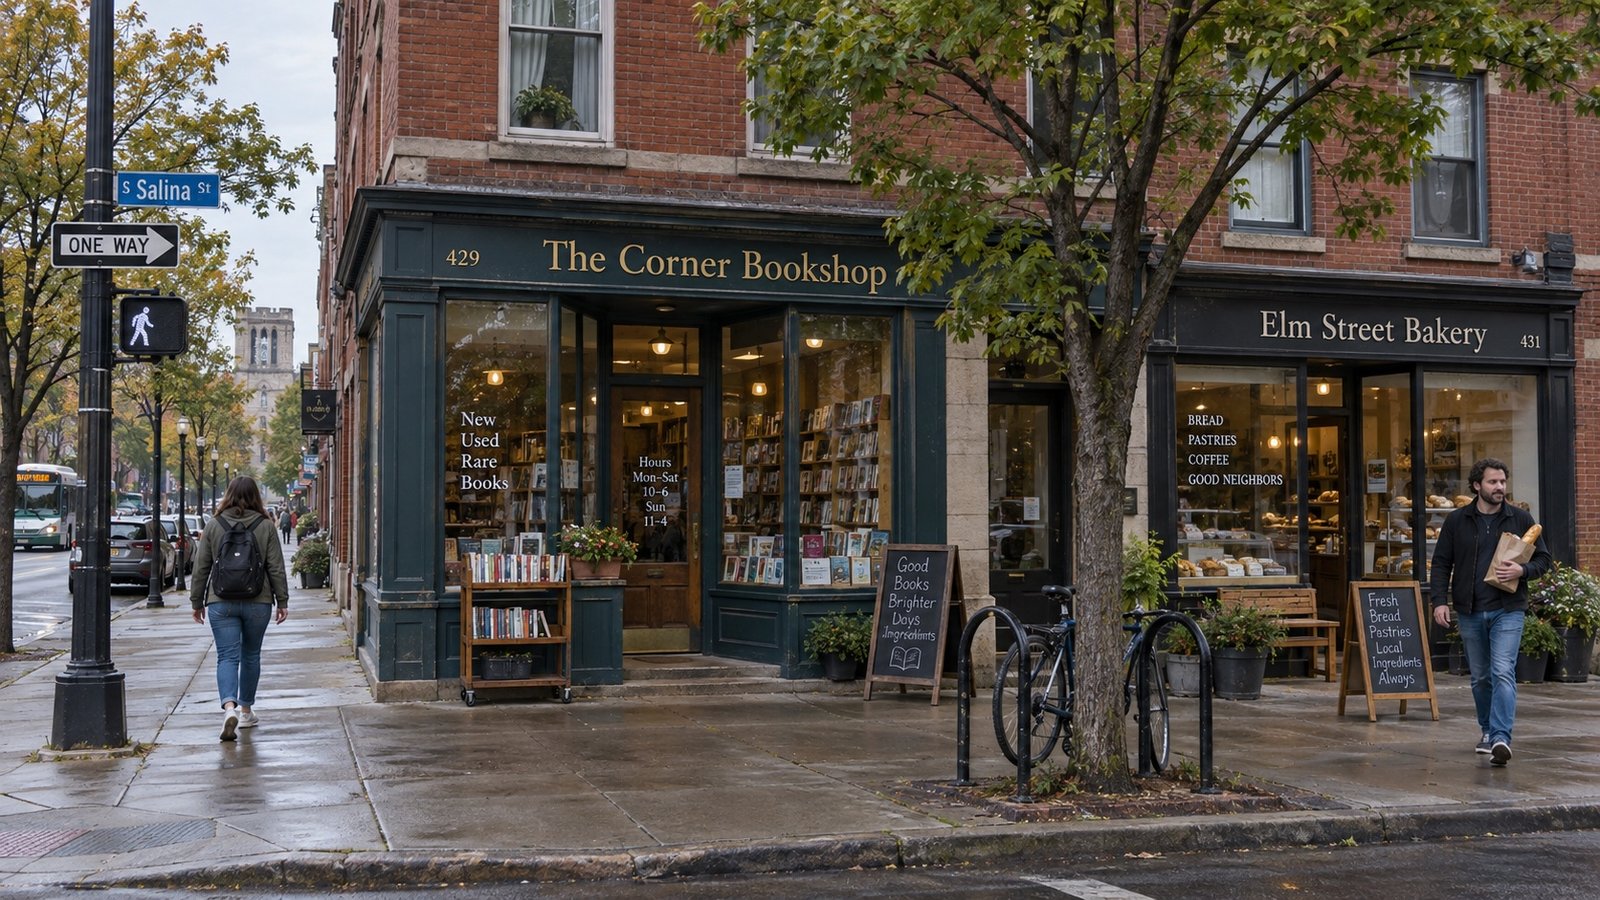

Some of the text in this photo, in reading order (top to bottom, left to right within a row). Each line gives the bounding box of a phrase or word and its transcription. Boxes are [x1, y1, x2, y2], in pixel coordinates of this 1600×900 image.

[122, 179, 211, 201] S Salina St
[69, 237, 149, 254] ONE WAY
[445, 248, 480, 267] 429
[542, 239, 888, 295] The Corner Bookshop
[1260, 310, 1488, 353] Elm Street Bakery
[1520, 334, 1541, 350] 431
[461, 411, 497, 427] New
[1187, 414, 1224, 427] BREAD
[461, 432, 500, 448] Used
[1188, 434, 1237, 447] PASTRIES
[461, 454, 498, 469] Rare
[639, 456, 672, 468] Hours
[1188, 453, 1230, 466] COFFEE
[461, 475, 509, 490] Books
[1188, 473, 1283, 487] GOOD NEIGHBORS
[645, 501, 666, 512] Sun
[897, 555, 929, 573] Good
[894, 575, 930, 591] Books
[888, 593, 937, 613] Brighter
[1368, 592, 1399, 608] Fresh
[1369, 609, 1402, 623] Bread
[1376, 640, 1403, 655] Local
[1372, 656, 1422, 672] Ingredients
[1378, 671, 1416, 689] Always
